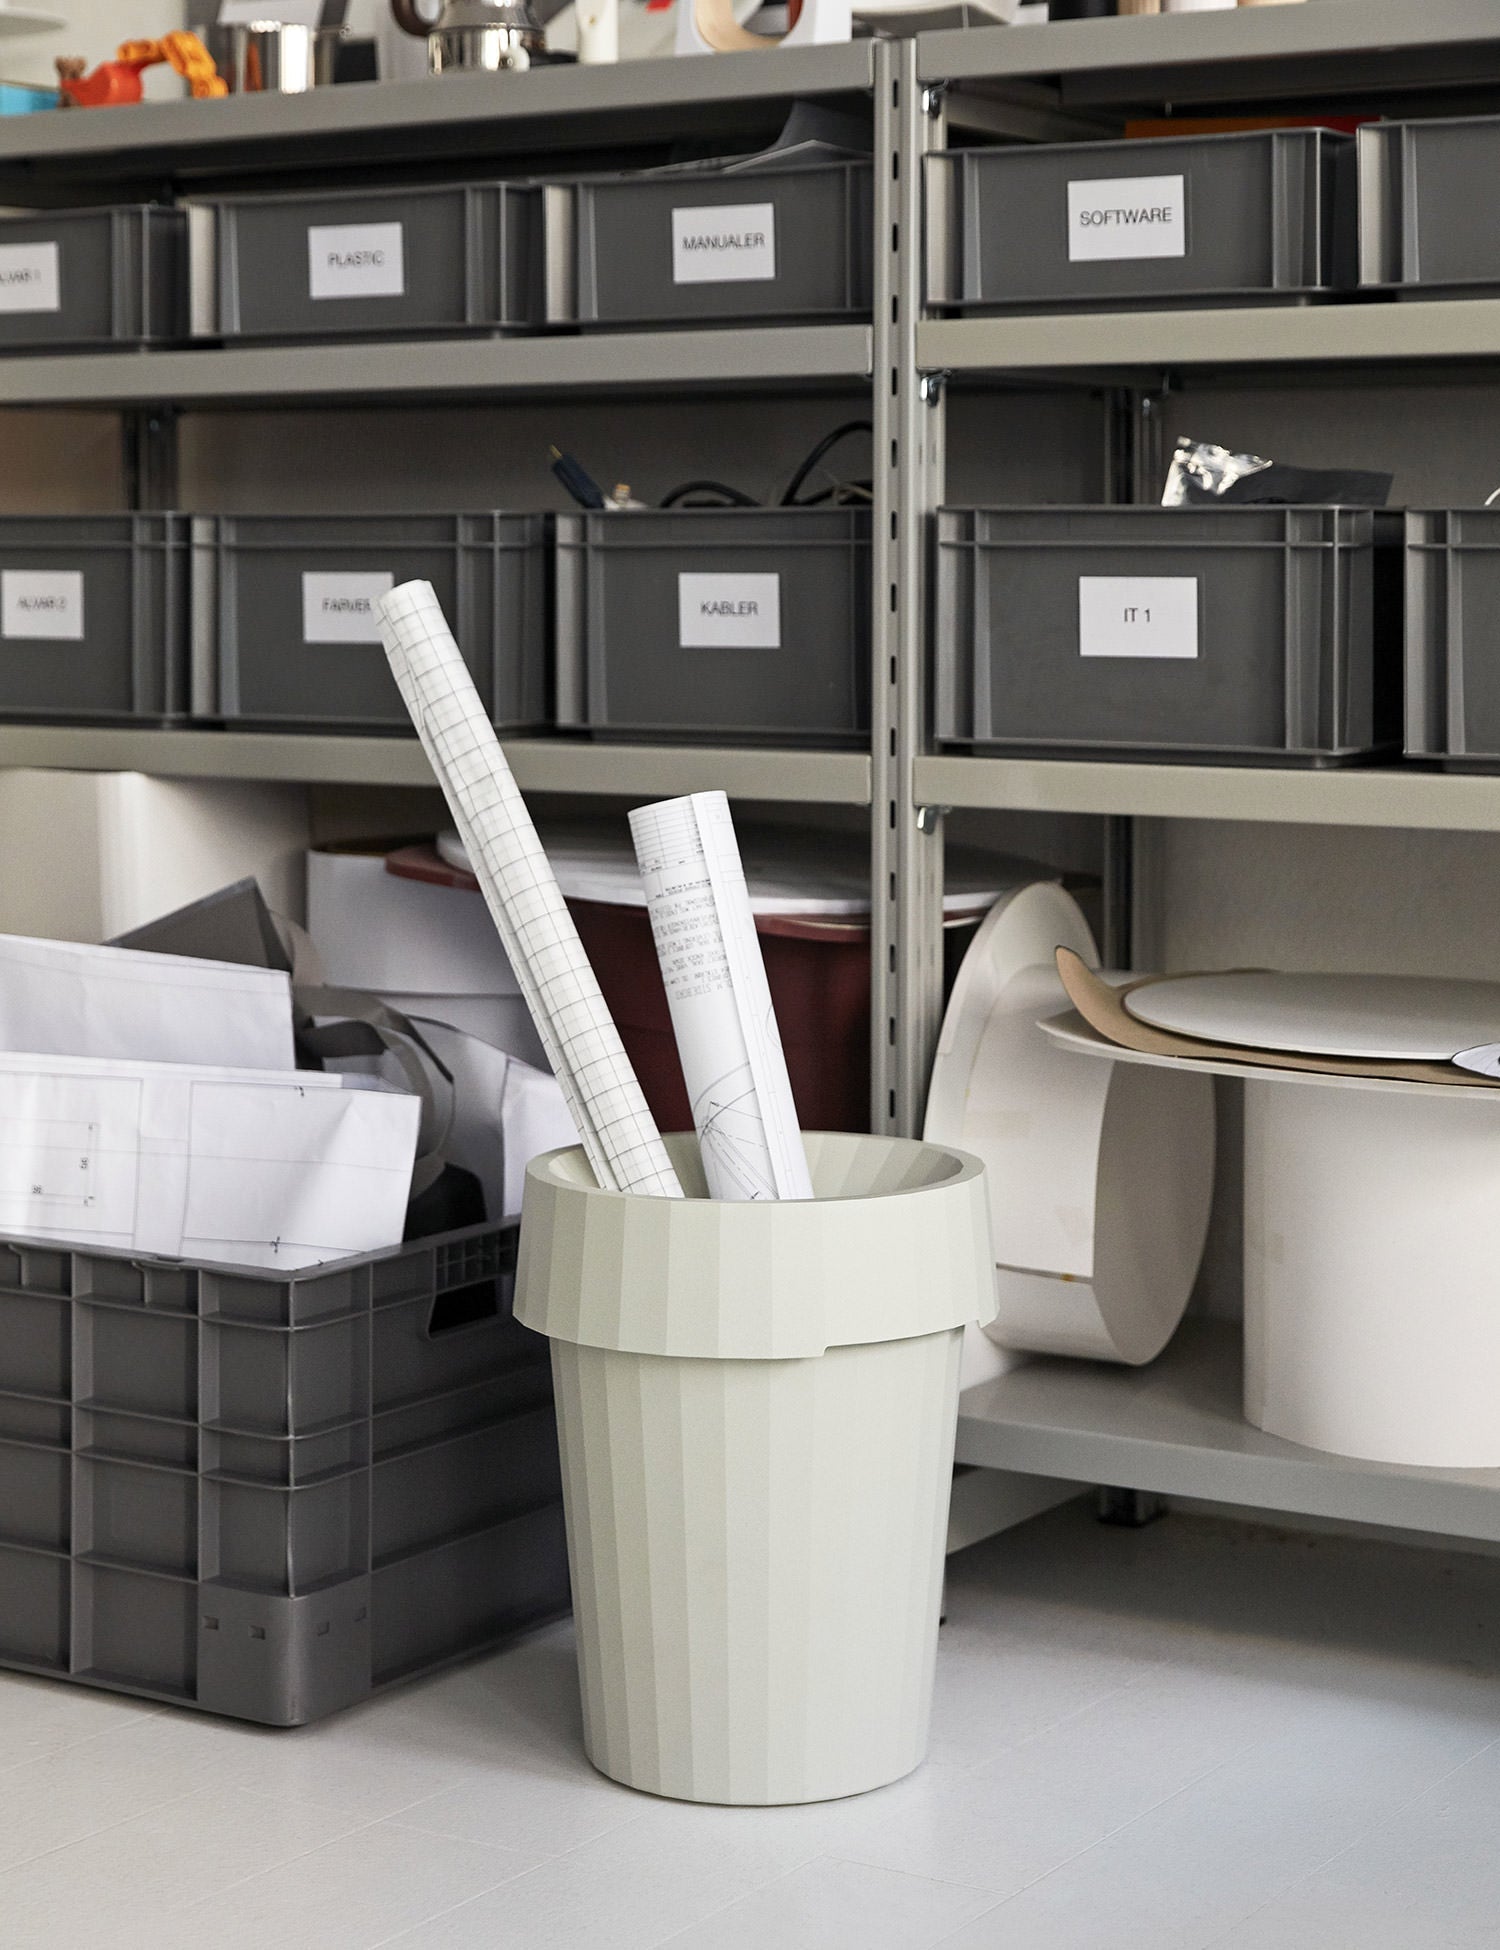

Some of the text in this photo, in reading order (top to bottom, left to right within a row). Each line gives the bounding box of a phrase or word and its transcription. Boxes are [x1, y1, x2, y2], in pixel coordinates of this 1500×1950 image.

[1080, 206, 1173, 226] SOFTWARE
[682, 232, 766, 250] MANUALER
[328, 250, 385, 268] PLASTIC
[700, 600, 759, 617] KABLER
[1124, 607, 1151, 622] IT 1
